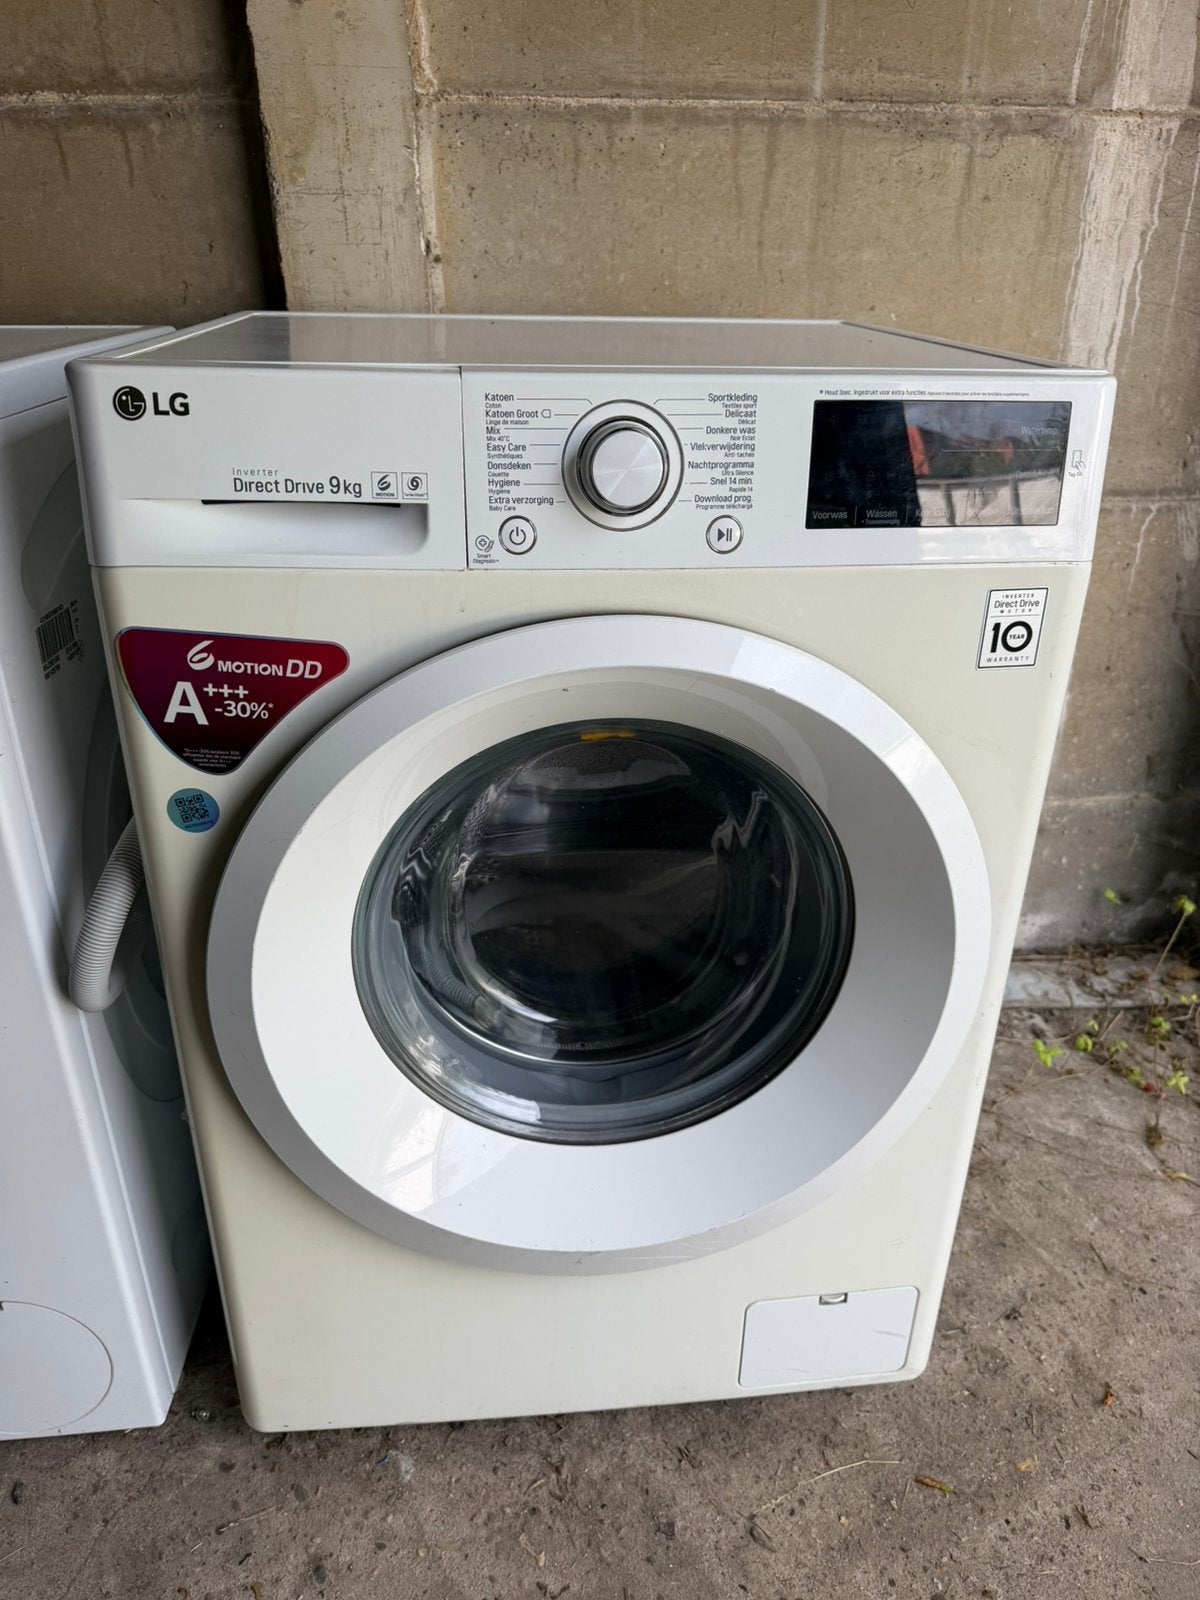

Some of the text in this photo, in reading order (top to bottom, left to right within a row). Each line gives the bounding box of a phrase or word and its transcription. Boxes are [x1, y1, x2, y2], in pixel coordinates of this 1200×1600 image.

[484, 392, 514, 402] Katoen
[906, 389, 926, 397] functies
[707, 393, 758, 404] Sportkleding
[153, 392, 190, 416] LG
[485, 409, 538, 418] Katoen Groot
[725, 408, 757, 418] Delicaat
[486, 427, 501, 435] Mix
[706, 426, 756, 435] Donkere was
[487, 442, 527, 453] Easy Care
[690, 442, 756, 453] Vlekverwijdering
[487, 461, 531, 471] Donsdeken
[688, 461, 755, 471] Nachtprogramma
[232, 467, 279, 477] Inverter
[233, 475, 363, 497] Direct Drive 9kg
[488, 478, 521, 488] Hygiene
[710, 477, 754, 486] Snel 14 min.
[729, 486, 746, 494] Rapide
[488, 496, 554, 506] Extra verzorging
[694, 494, 754, 504] Download prog.
[812, 510, 848, 519] Voorwas
[866, 509, 898, 518] Wassen
[994, 598, 1040, 609] Direct Drive
[990, 620, 1033, 653] 10
[217, 660, 284, 677] MOTION
[285, 659, 323, 679] DD
